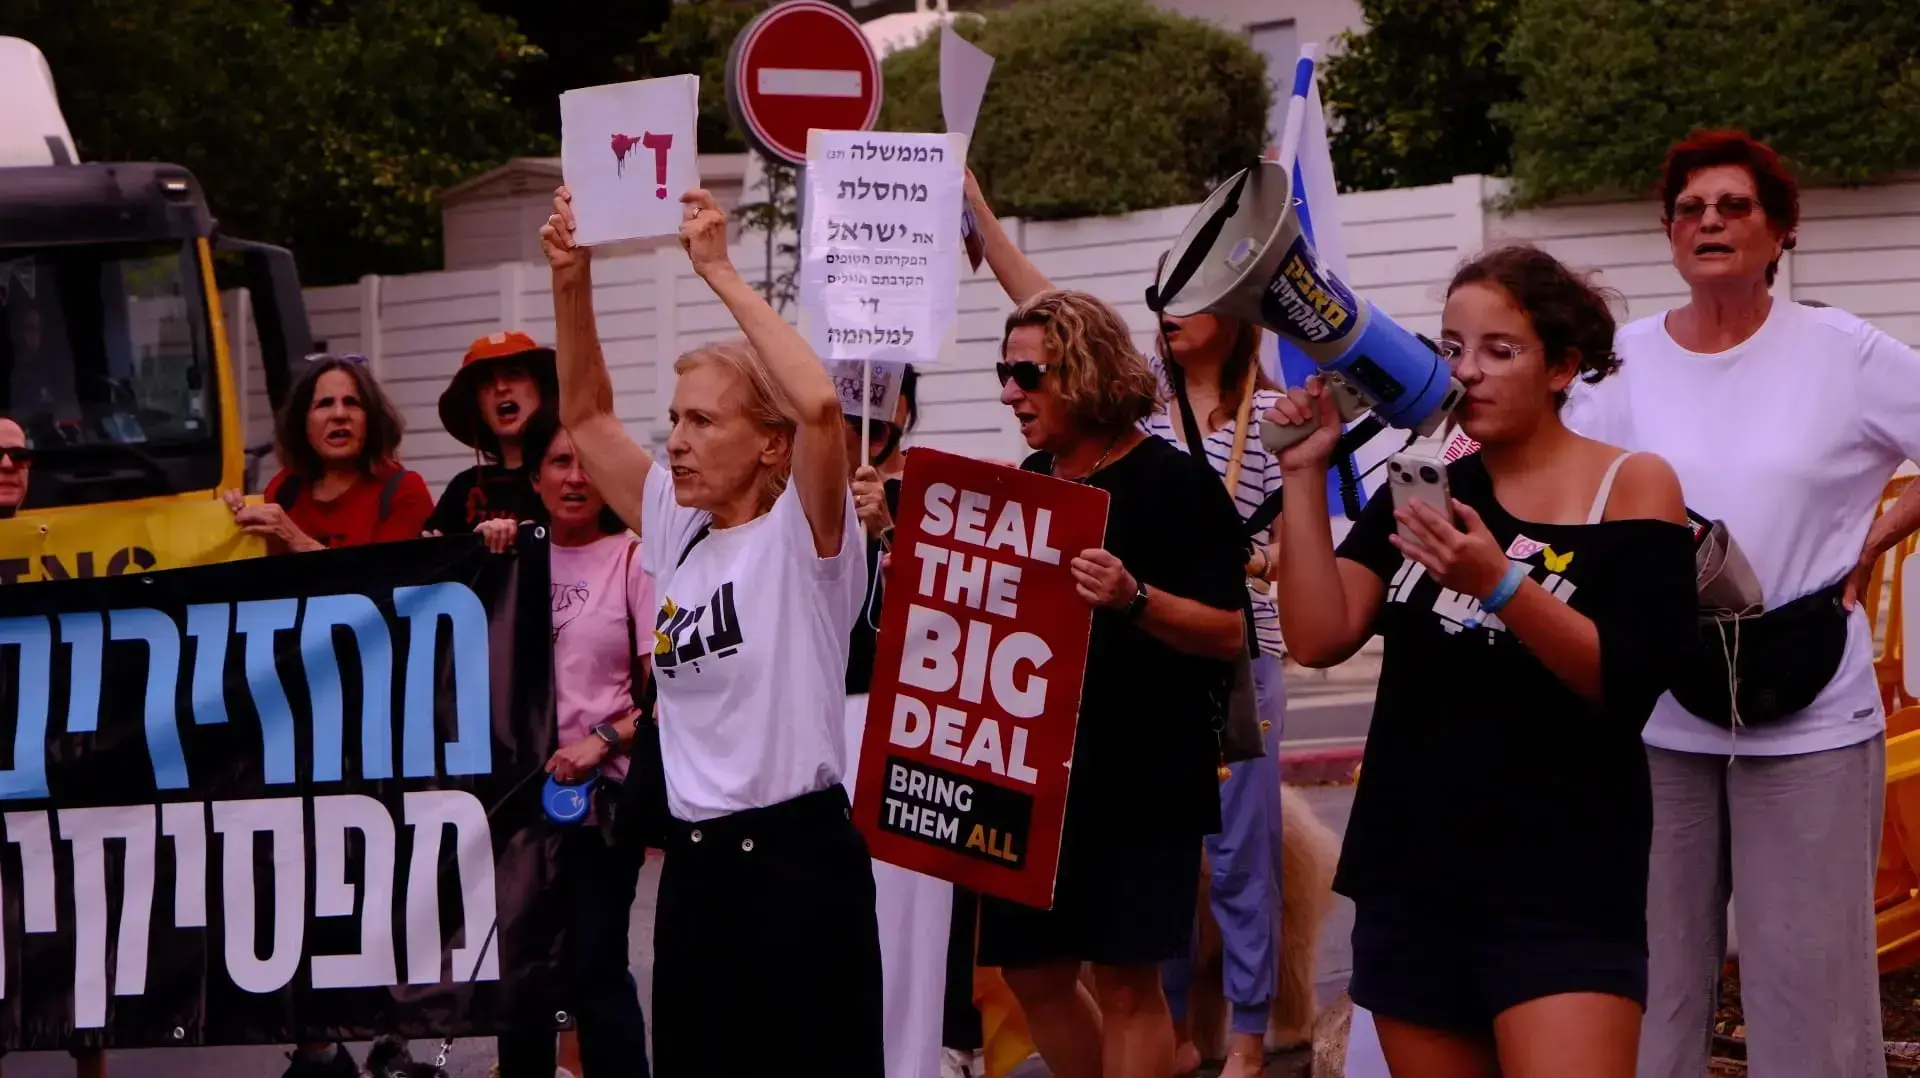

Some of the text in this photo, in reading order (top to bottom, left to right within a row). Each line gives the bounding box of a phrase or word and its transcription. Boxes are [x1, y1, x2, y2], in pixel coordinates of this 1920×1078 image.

[850, 140, 944, 163] הממשלה
[837, 176, 928, 202] מחסלת
[827, 219, 934, 244] את ישראל
[859, 298, 880, 313] די
[827, 325, 914, 345] למלחמה
[920, 482, 1061, 565] SEAL
[914, 542, 1022, 619] THE
[898, 603, 1054, 719] BIG
[889, 693, 1038, 785] DEAL
[889, 764, 974, 812] BRING
[885, 798, 1018, 863] THEM ALL
[0, 789, 500, 1028] מפסיקי
